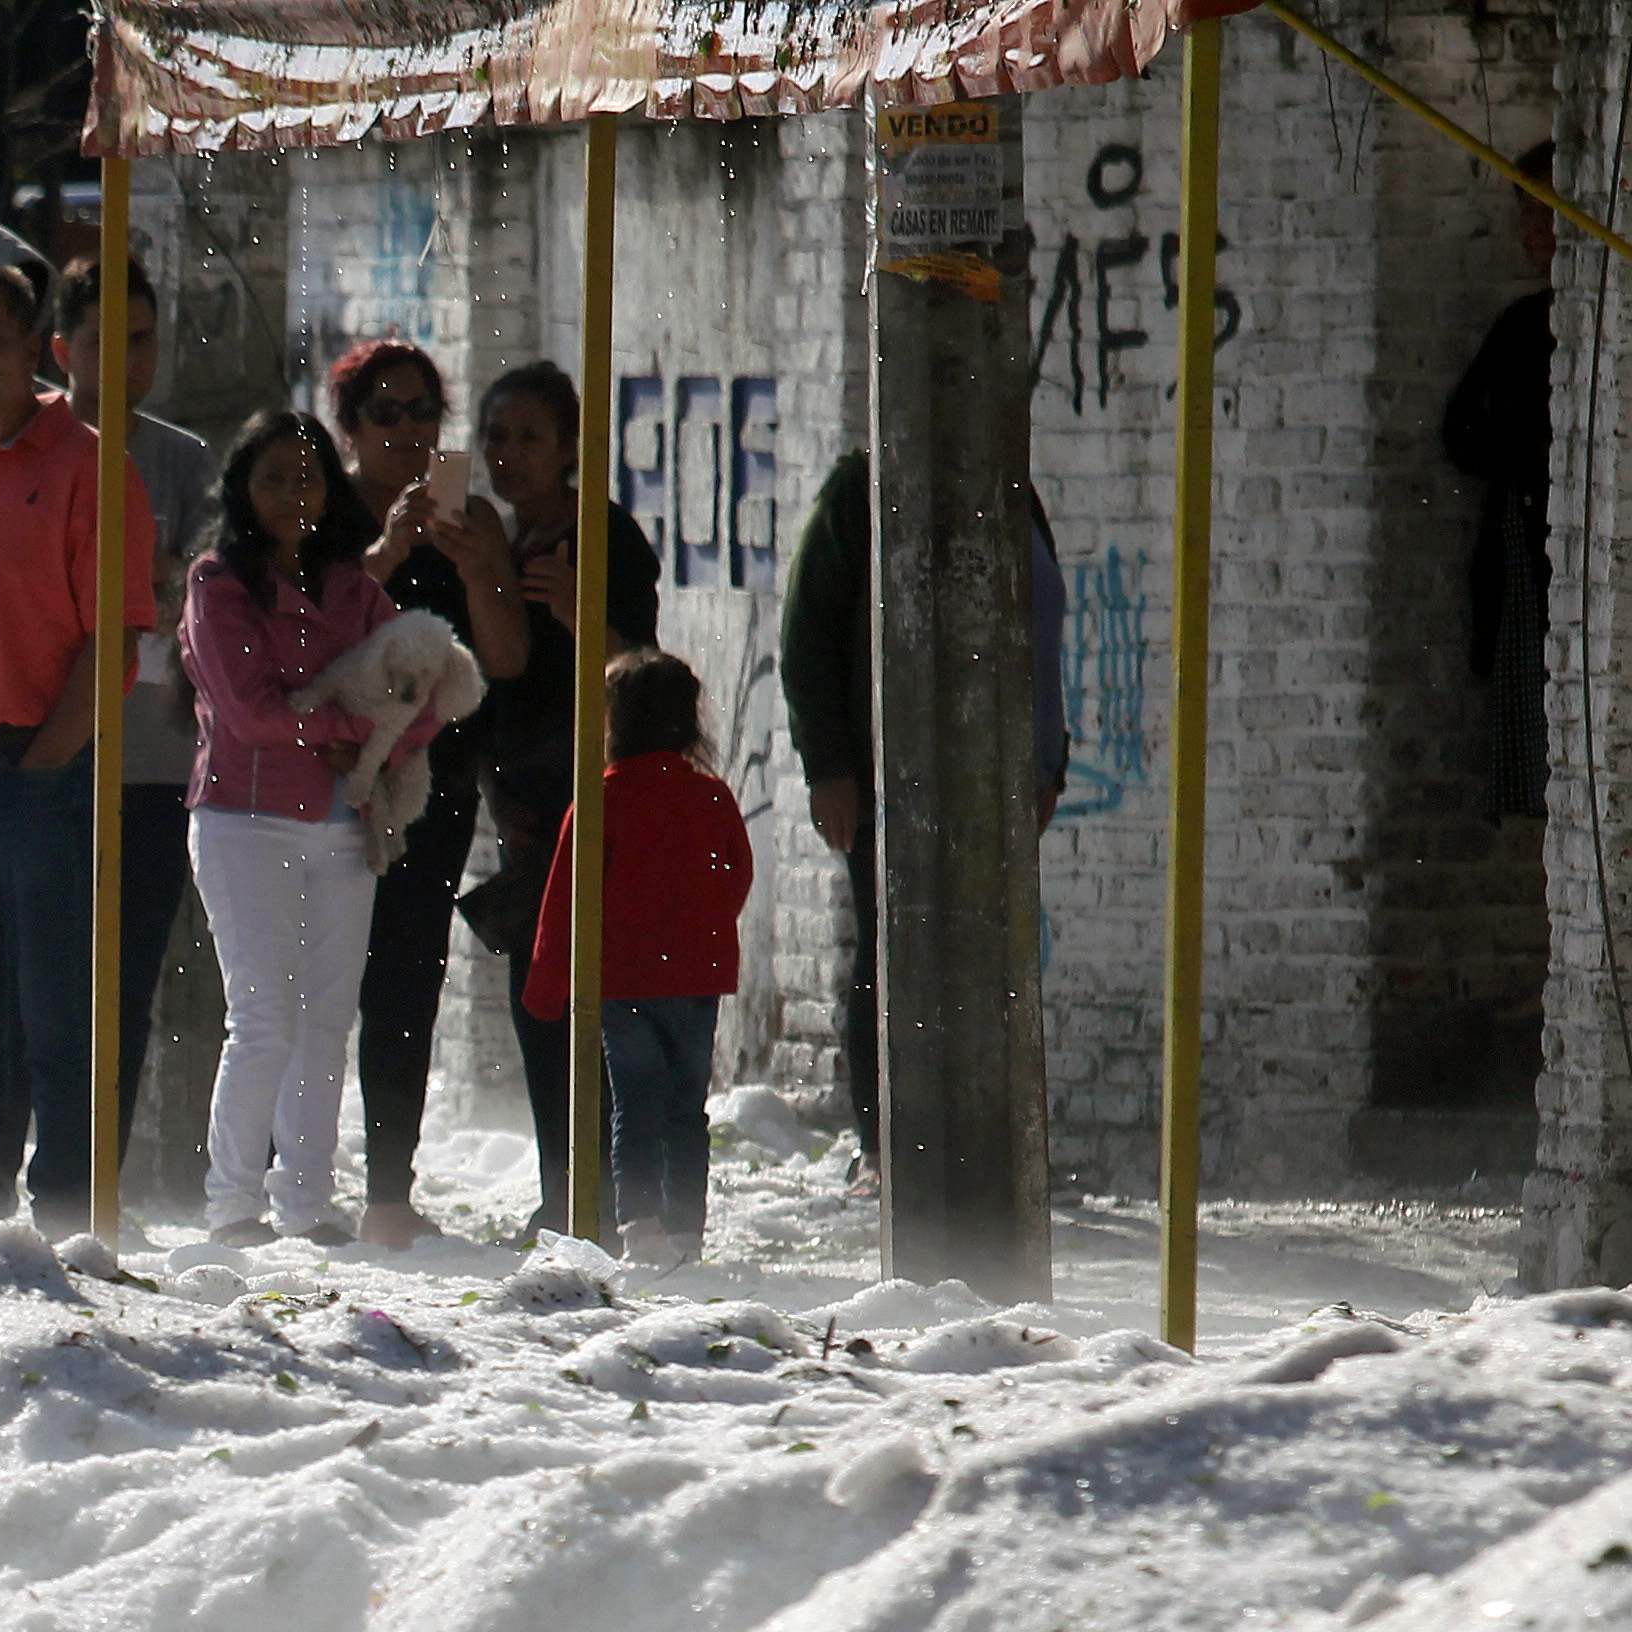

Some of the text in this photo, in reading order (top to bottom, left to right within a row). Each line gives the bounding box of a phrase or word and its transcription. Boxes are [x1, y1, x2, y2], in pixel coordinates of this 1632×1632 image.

[888, 114, 990, 138] VENDO
[890, 208, 926, 237] CASAS
[929, 208, 947, 236] EN
